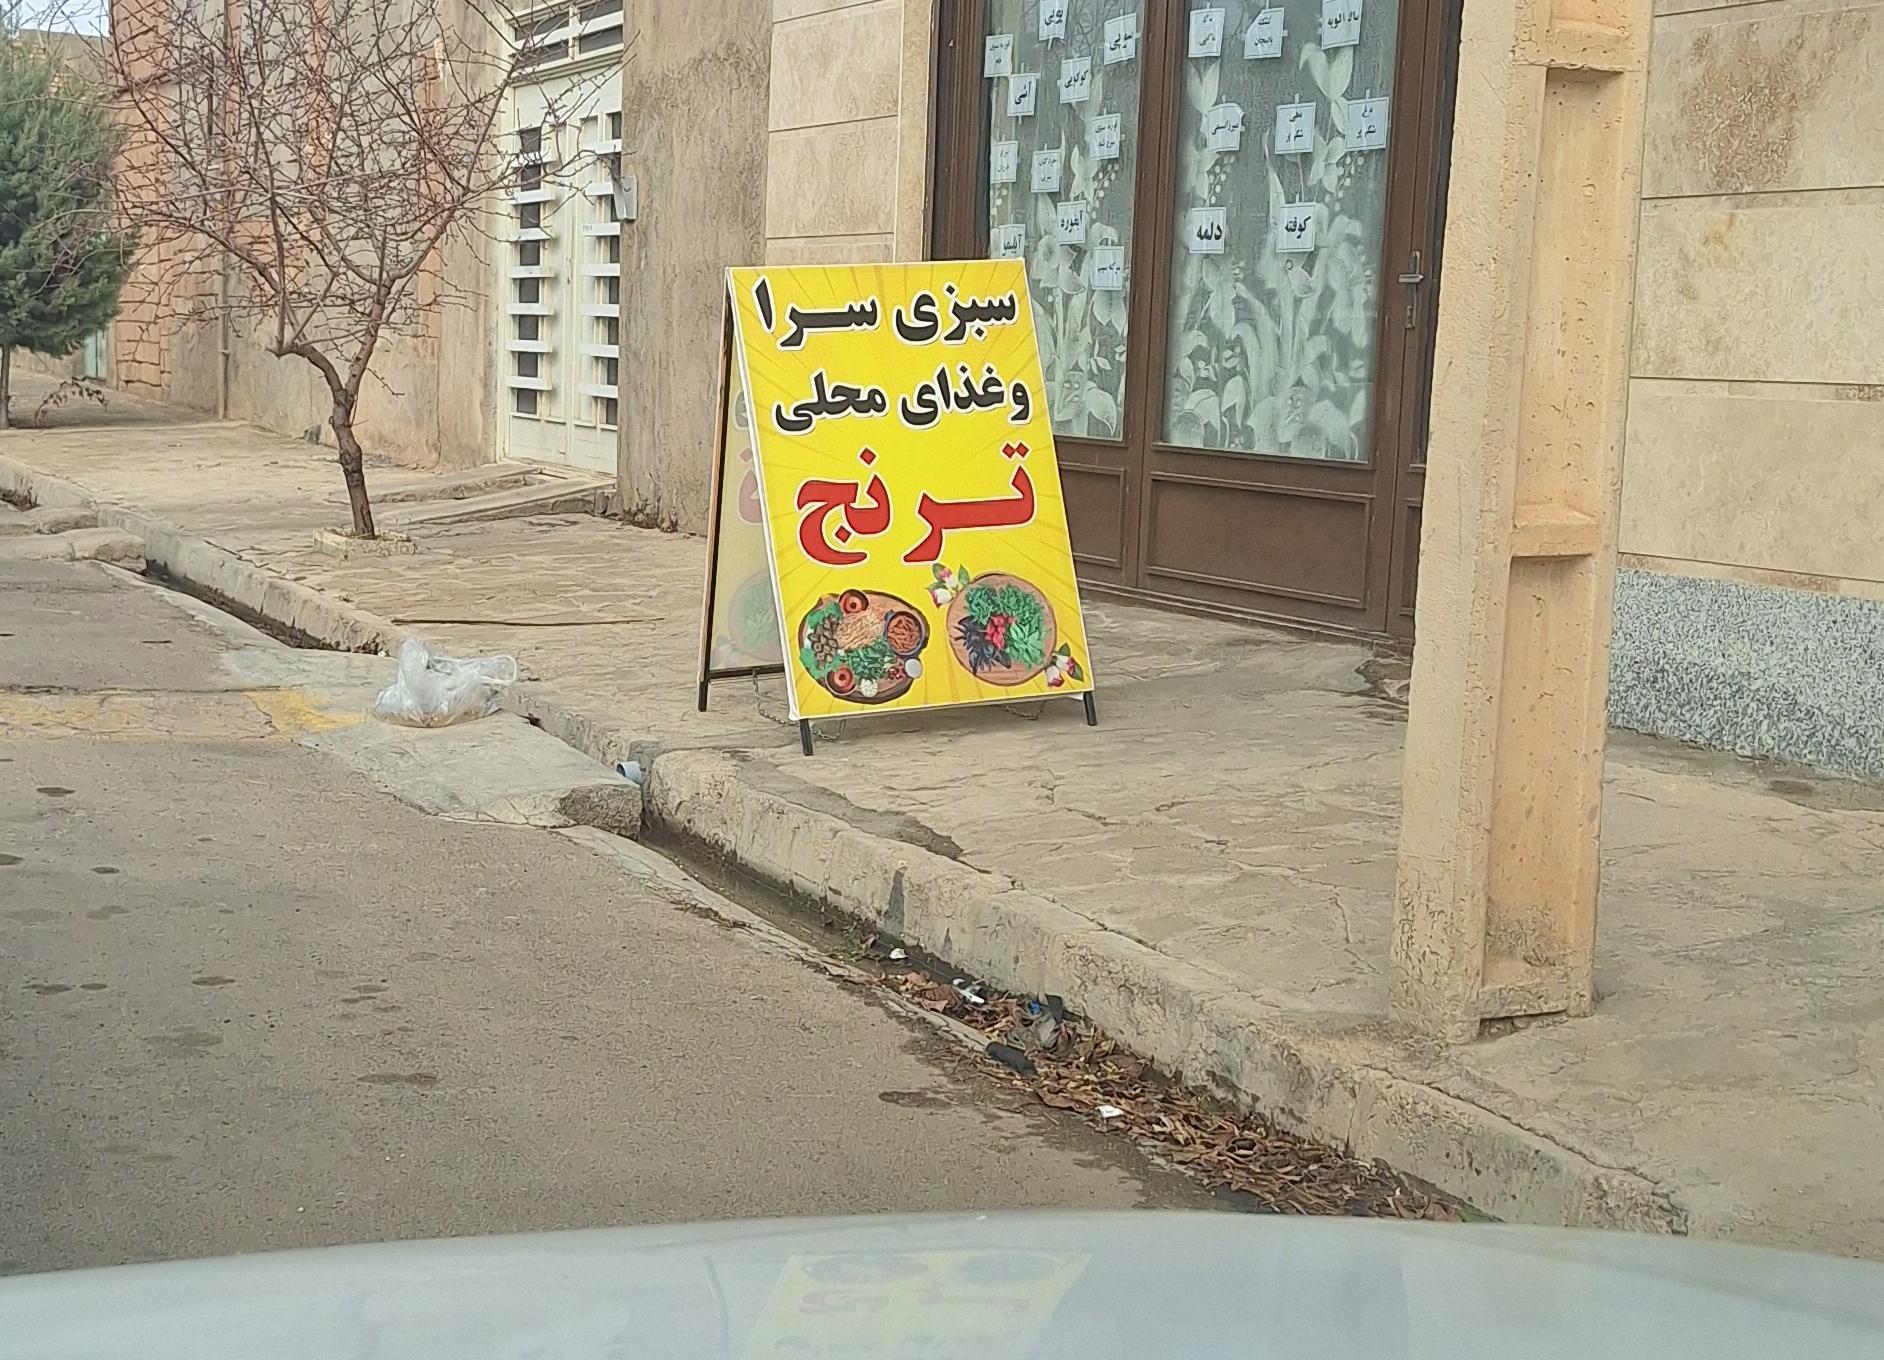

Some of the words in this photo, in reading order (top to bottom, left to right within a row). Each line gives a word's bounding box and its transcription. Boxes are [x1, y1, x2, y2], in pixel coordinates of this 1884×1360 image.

[1061, 210, 1083, 233] آبغوره
[1196, 221, 1222, 241] دلمه
[1284, 216, 1312, 239] کوفته
[755, 279, 878, 347] سرا
[896, 282, 1017, 342] سبزی
[775, 371, 887, 431] محلی
[797, 442, 1035, 564] ترنج
